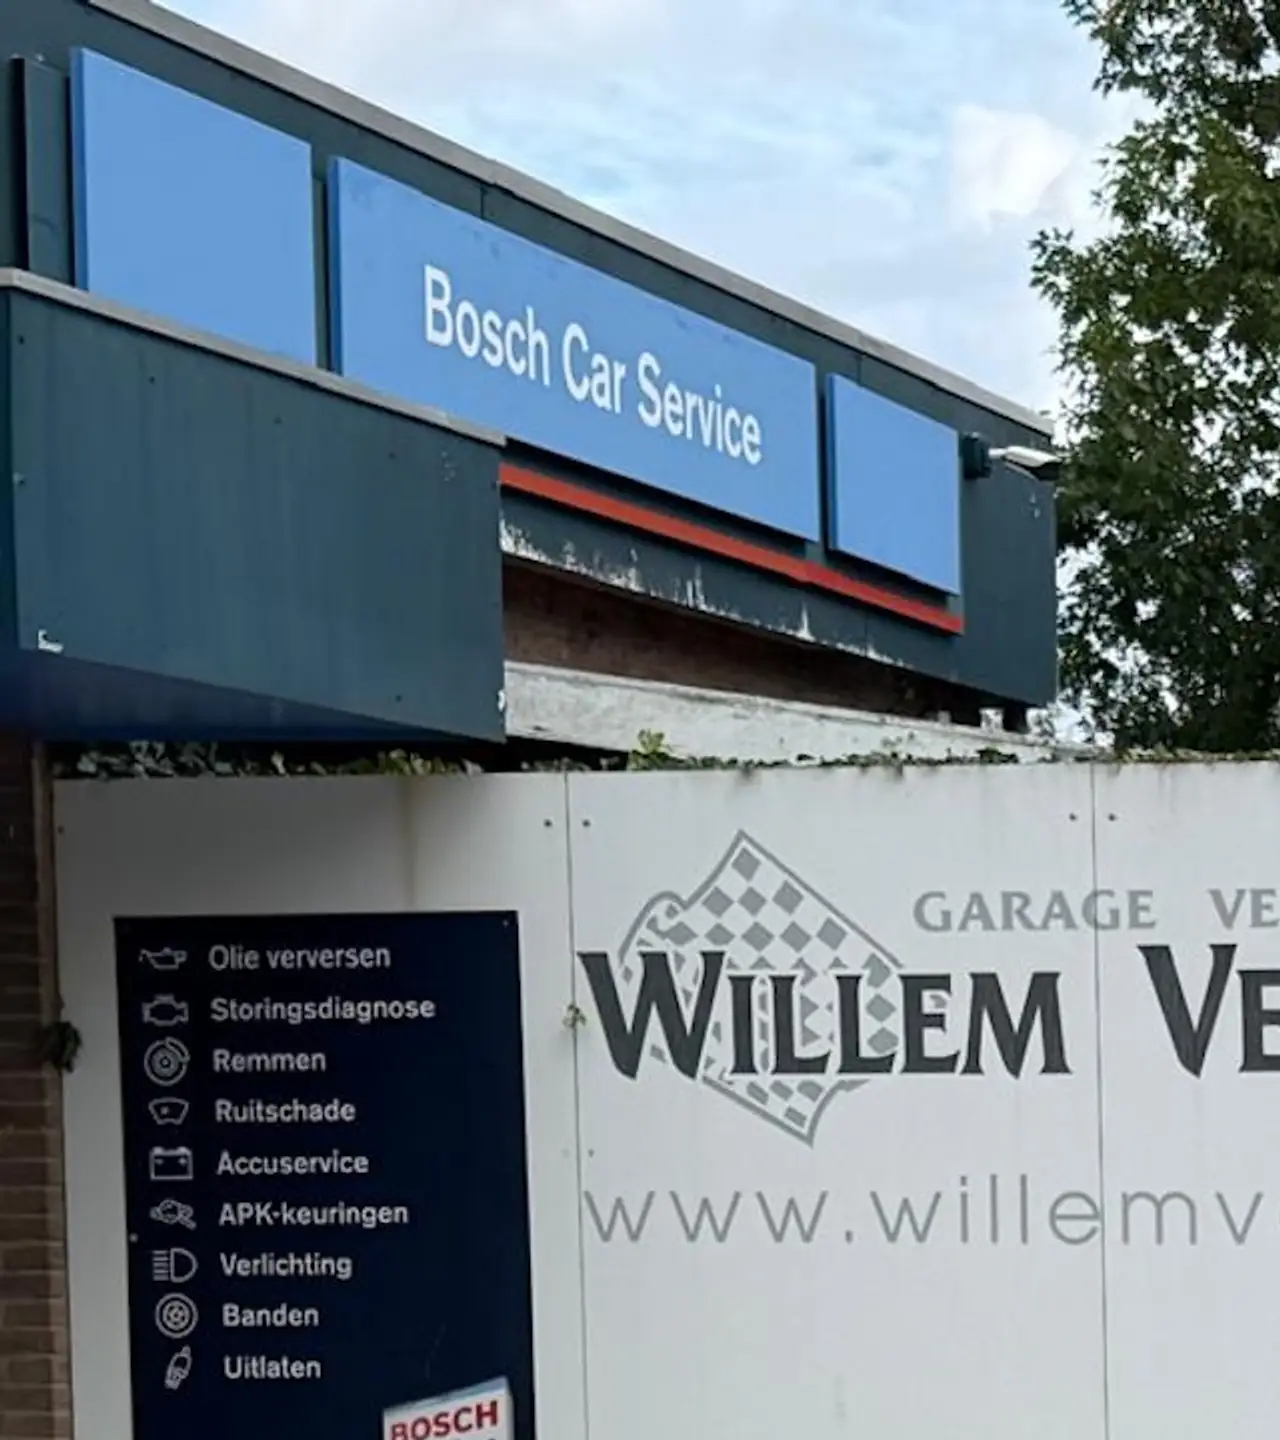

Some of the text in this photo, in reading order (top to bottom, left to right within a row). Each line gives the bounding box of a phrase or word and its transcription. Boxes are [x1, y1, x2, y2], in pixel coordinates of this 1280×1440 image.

[424, 264, 762, 465] Bosch Car Service
[912, 888, 1157, 932] GARAGE
[208, 945, 391, 970] Olie verversen
[210, 997, 437, 1024] Storingsdiagnose
[212, 1048, 326, 1073] Remmen
[214, 1098, 356, 1123] Ruitschade
[216, 1149, 369, 1175] Accuservice
[218, 1202, 409, 1228] APK-keuringen
[219, 1252, 353, 1280] Verlichting
[222, 1303, 319, 1327] Banden
[223, 1355, 321, 1379] Uitlaten
